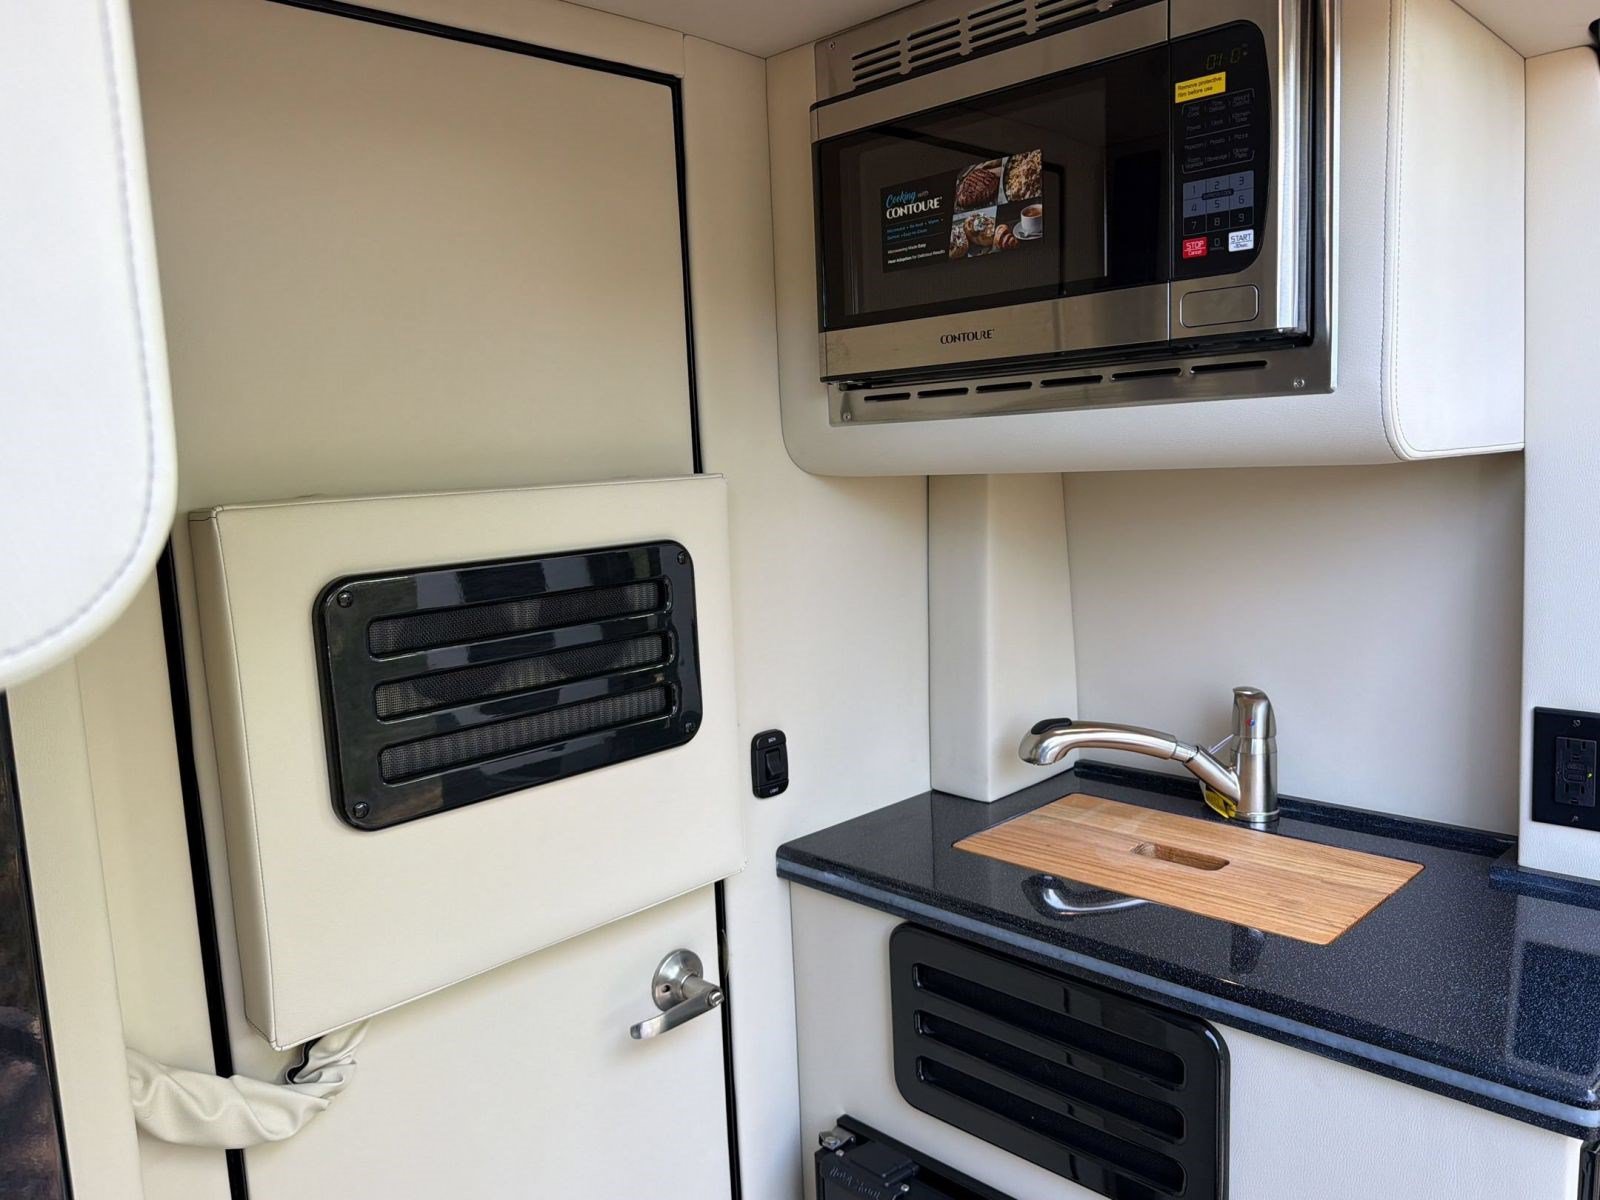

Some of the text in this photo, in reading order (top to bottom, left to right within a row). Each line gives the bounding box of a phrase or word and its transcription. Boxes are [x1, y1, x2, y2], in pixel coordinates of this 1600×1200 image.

[1178, 76, 1222, 90] Remove protective
[1188, 88, 1203, 96] before
[885, 190, 916, 208] Cooking
[886, 198, 940, 220] CONTOURE
[1186, 240, 1204, 249] STOP
[1230, 233, 1252, 243] START
[940, 329, 992, 344] CONTOURE
